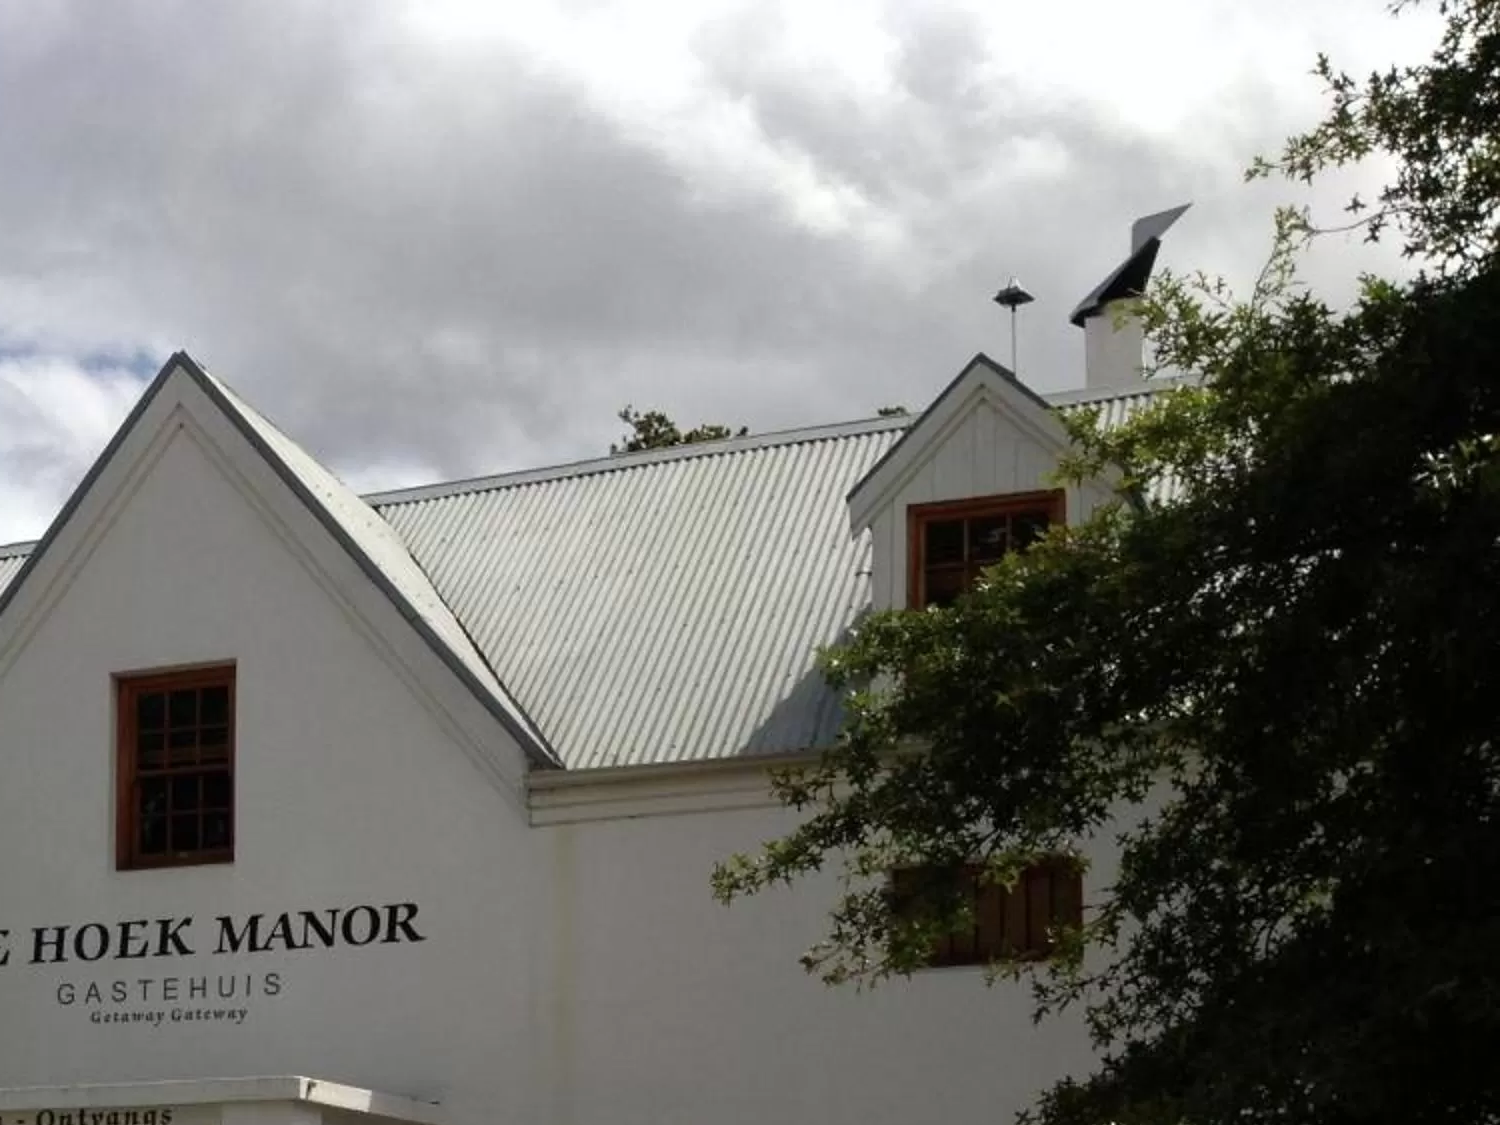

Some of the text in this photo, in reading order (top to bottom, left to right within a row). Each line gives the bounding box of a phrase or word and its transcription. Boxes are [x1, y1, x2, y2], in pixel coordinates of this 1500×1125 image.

[29, 917, 196, 965] HOEK
[212, 903, 427, 954] MANOR
[56, 972, 282, 1006] GASTEHUIS
[89, 1007, 249, 1028] Getaway Gateway
